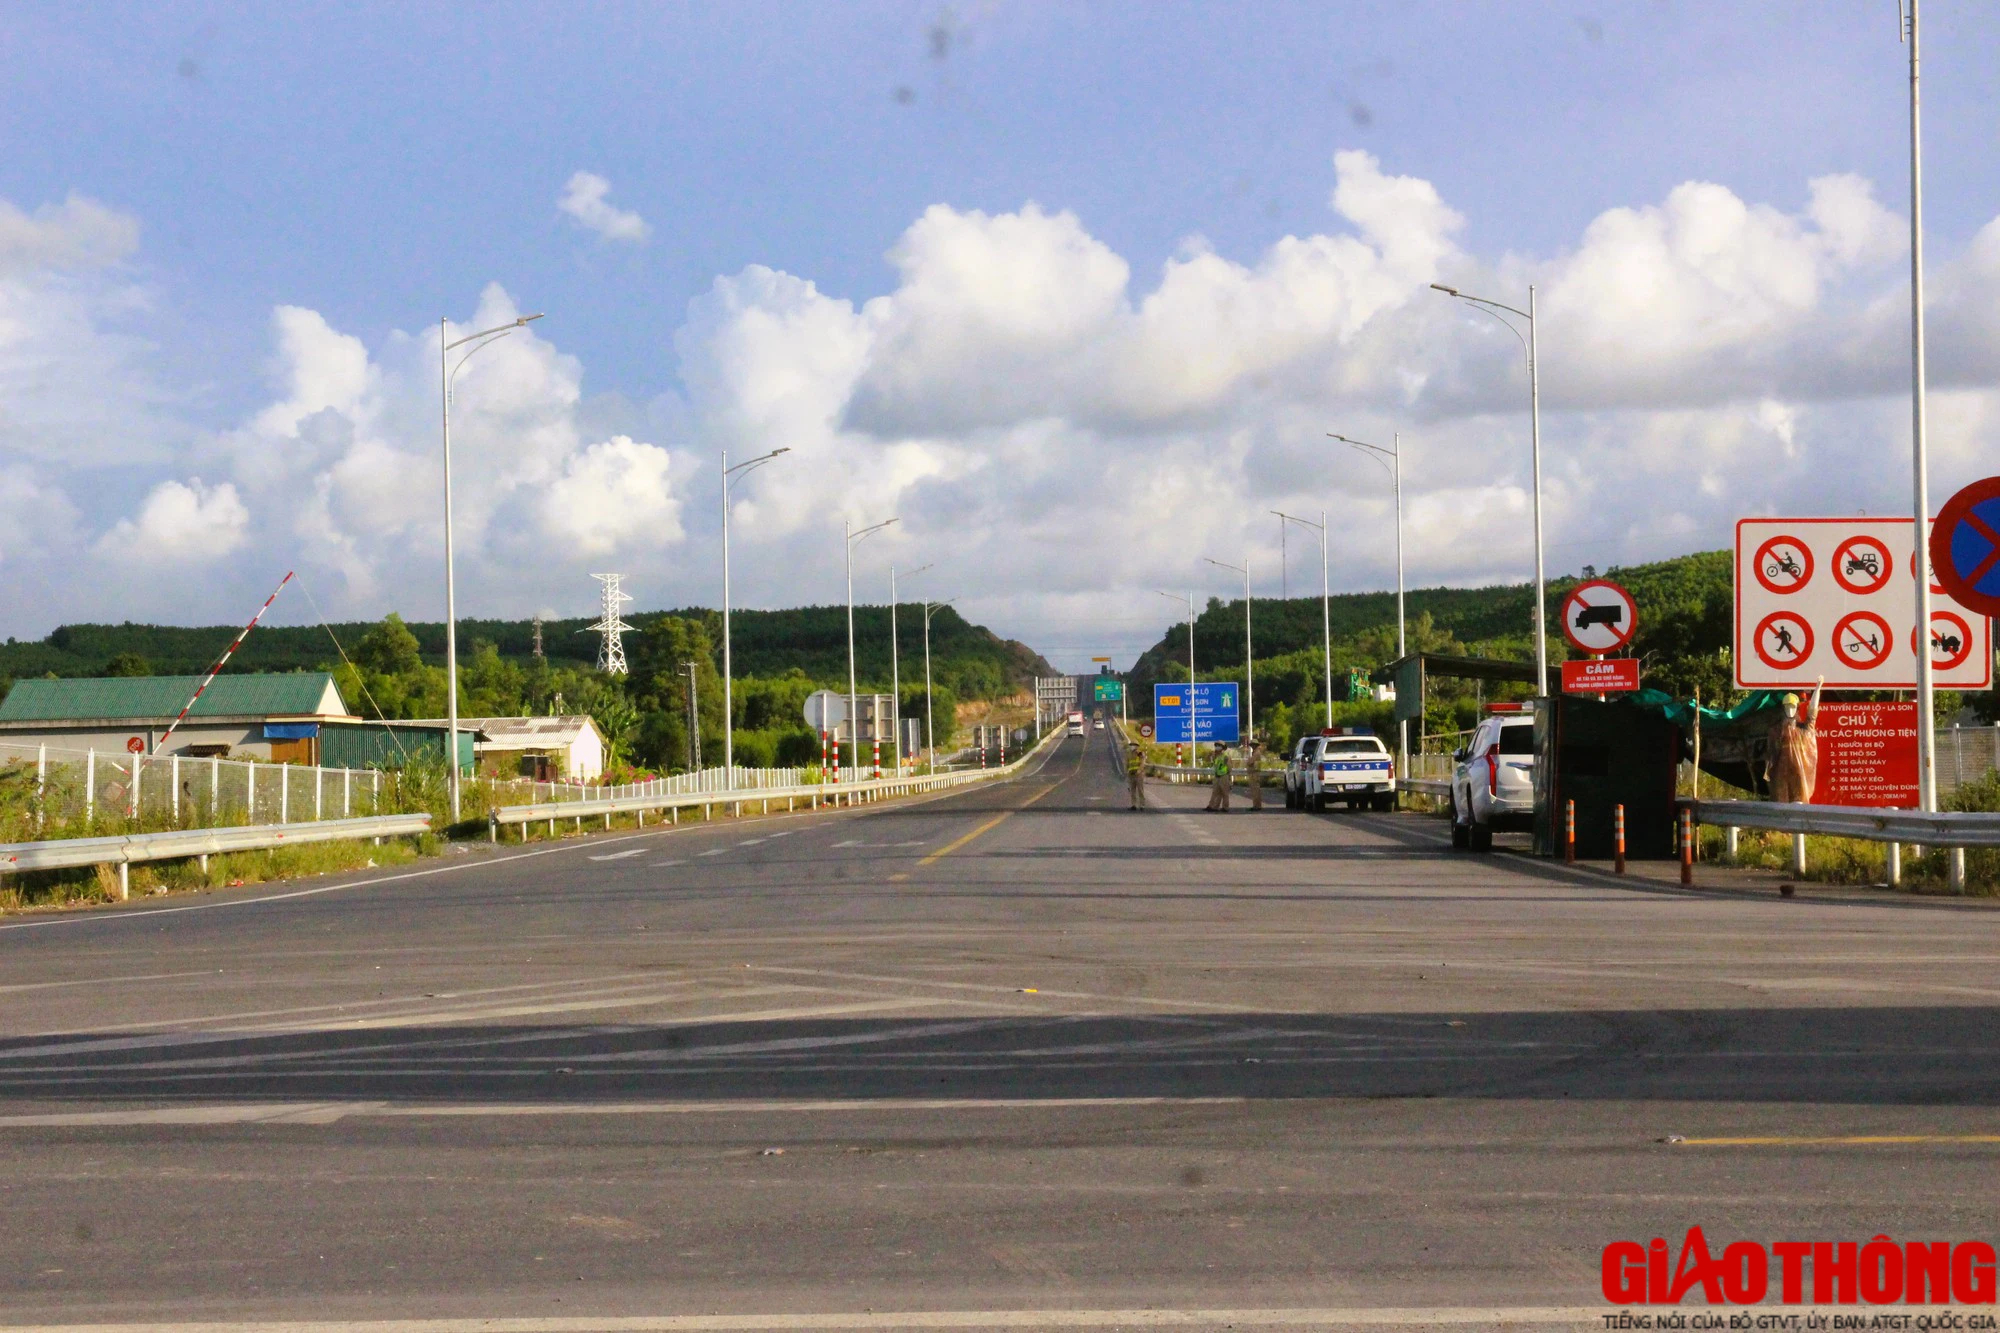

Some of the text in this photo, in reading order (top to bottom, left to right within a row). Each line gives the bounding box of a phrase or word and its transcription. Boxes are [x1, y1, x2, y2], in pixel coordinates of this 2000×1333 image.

[1830, 703, 1851, 711] TUYẾN
[1838, 712, 1882, 726] CHÚ Ý:
[1830, 728, 1852, 737] CÁC
[1854, 729, 1896, 737] PHƯƠNG
[1898, 728, 1916, 738] TIỆN
[1874, 741, 1884, 749] BỘ
